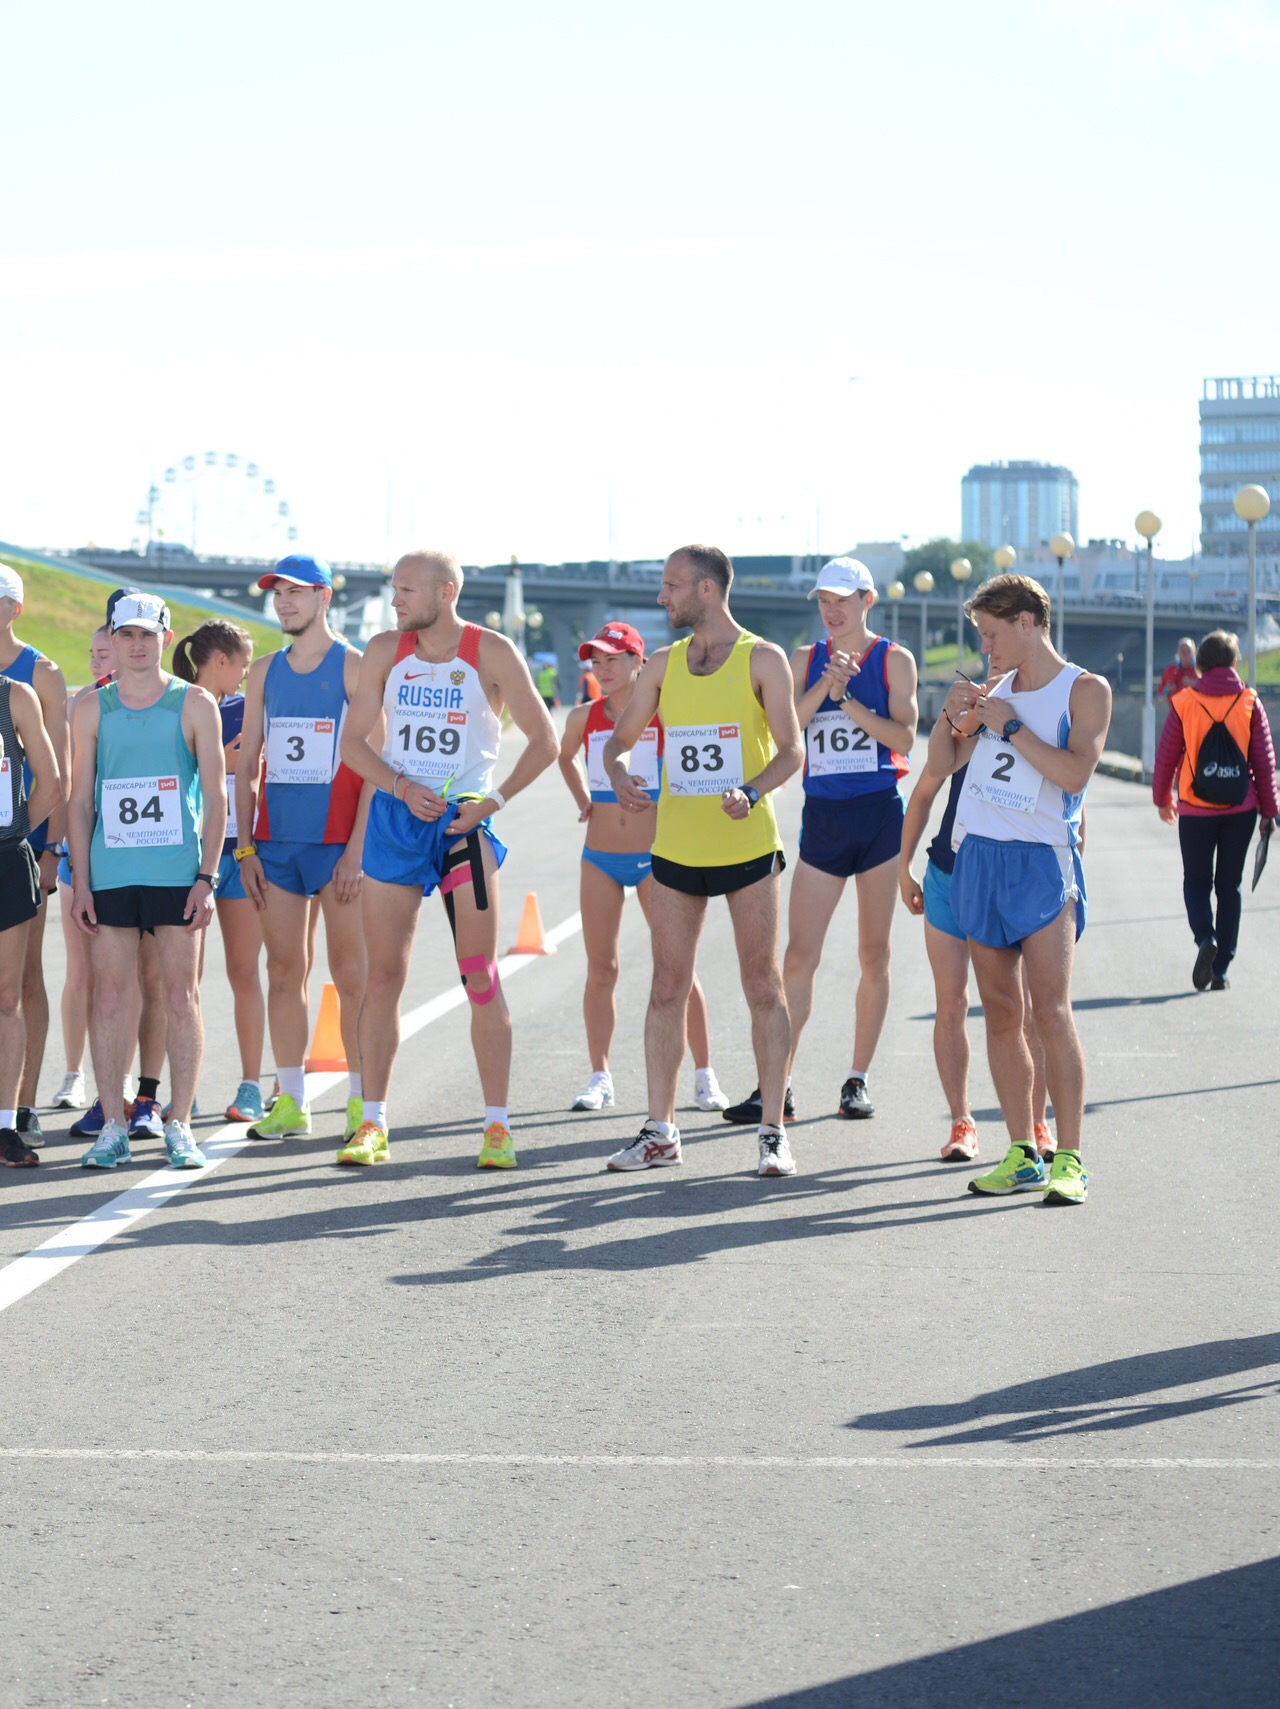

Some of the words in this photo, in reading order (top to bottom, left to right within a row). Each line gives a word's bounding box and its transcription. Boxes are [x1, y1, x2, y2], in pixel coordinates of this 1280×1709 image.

[398, 685, 463, 708] RUSSIA
[286, 736, 305, 762] 3
[398, 724, 460, 756] 169
[813, 728, 871, 754] 162
[680, 744, 724, 772] 83
[991, 752, 1016, 783] 2
[687, 777, 740, 787] ЧЕМПИОНАТ
[1217, 765, 1240, 778] asics
[118, 795, 164, 825] 84
[126, 829, 179, 839] ЧЕМПИОНАТ
